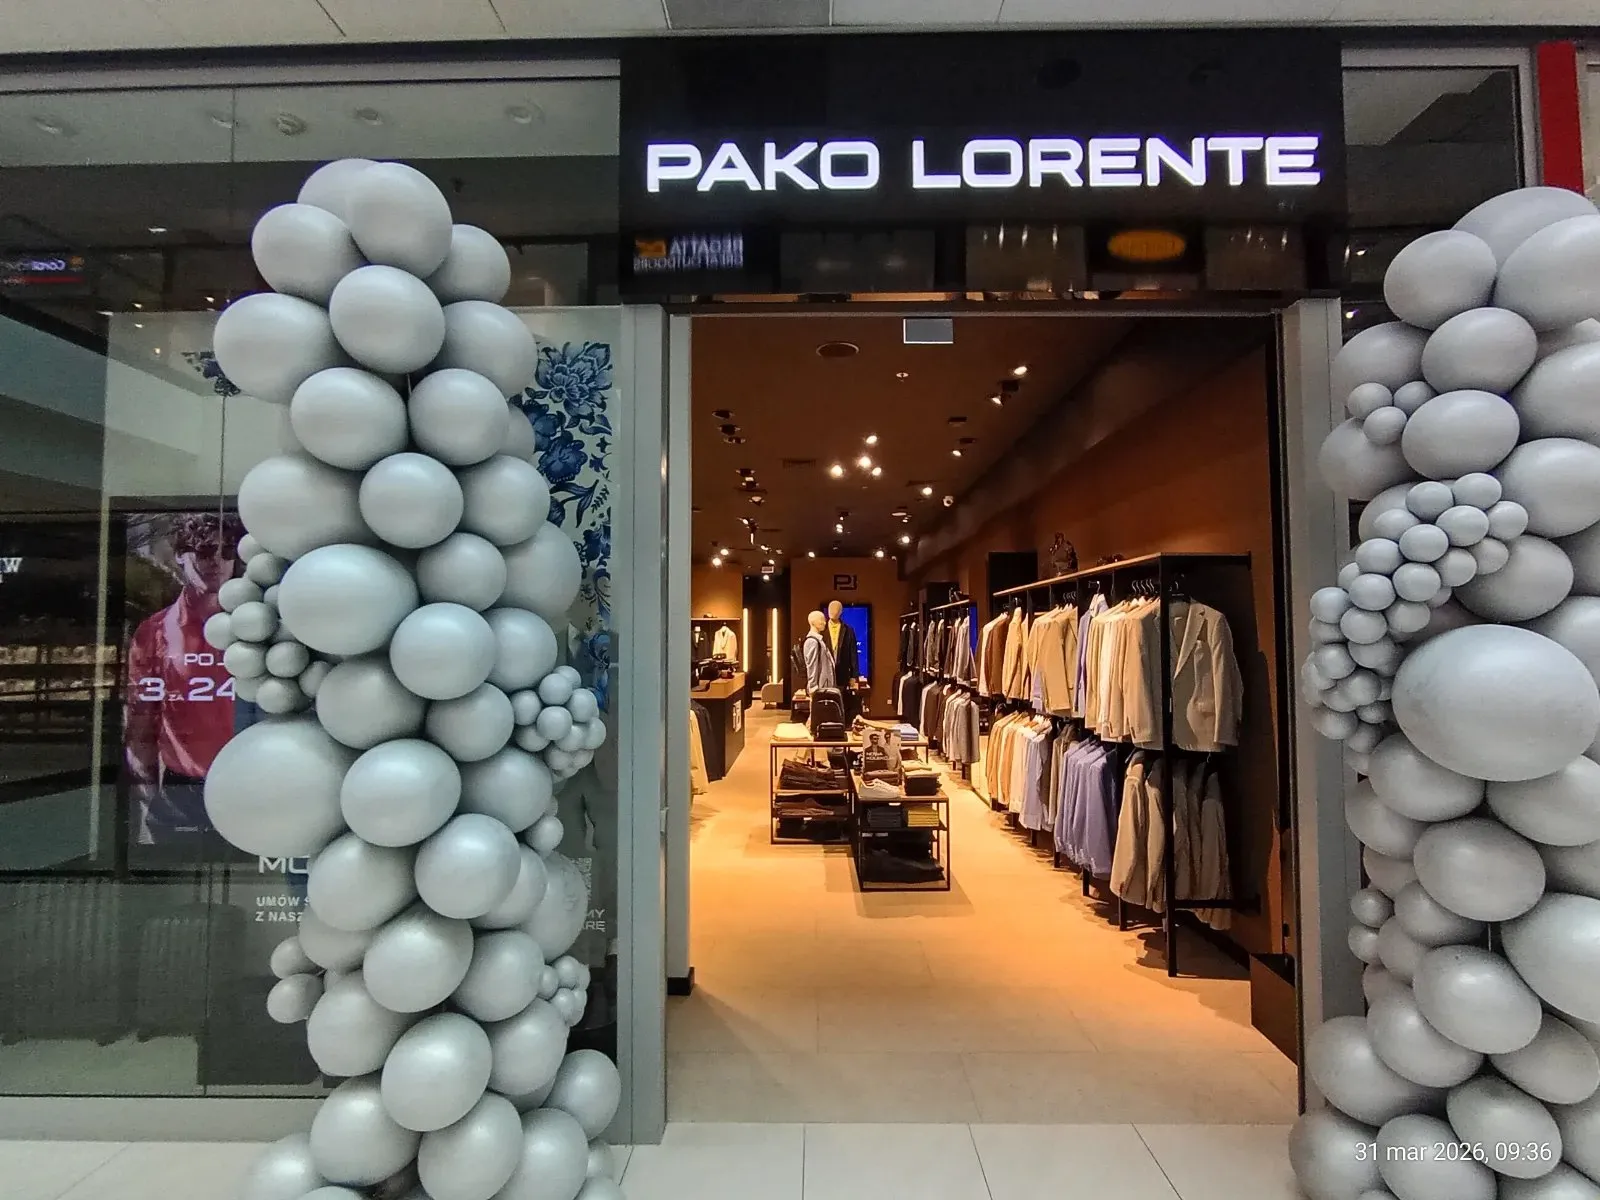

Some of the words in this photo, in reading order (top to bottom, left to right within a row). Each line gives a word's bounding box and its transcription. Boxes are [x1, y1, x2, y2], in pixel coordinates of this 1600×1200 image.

[646, 140, 880, 192] PAKO
[911, 136, 1322, 189] LORENTE
[184, 653, 215, 666] PO
[138, 677, 166, 702] 3
[256, 895, 300, 907] UMÓW
[255, 911, 264, 922] Z
[268, 911, 304, 922] NASZ
